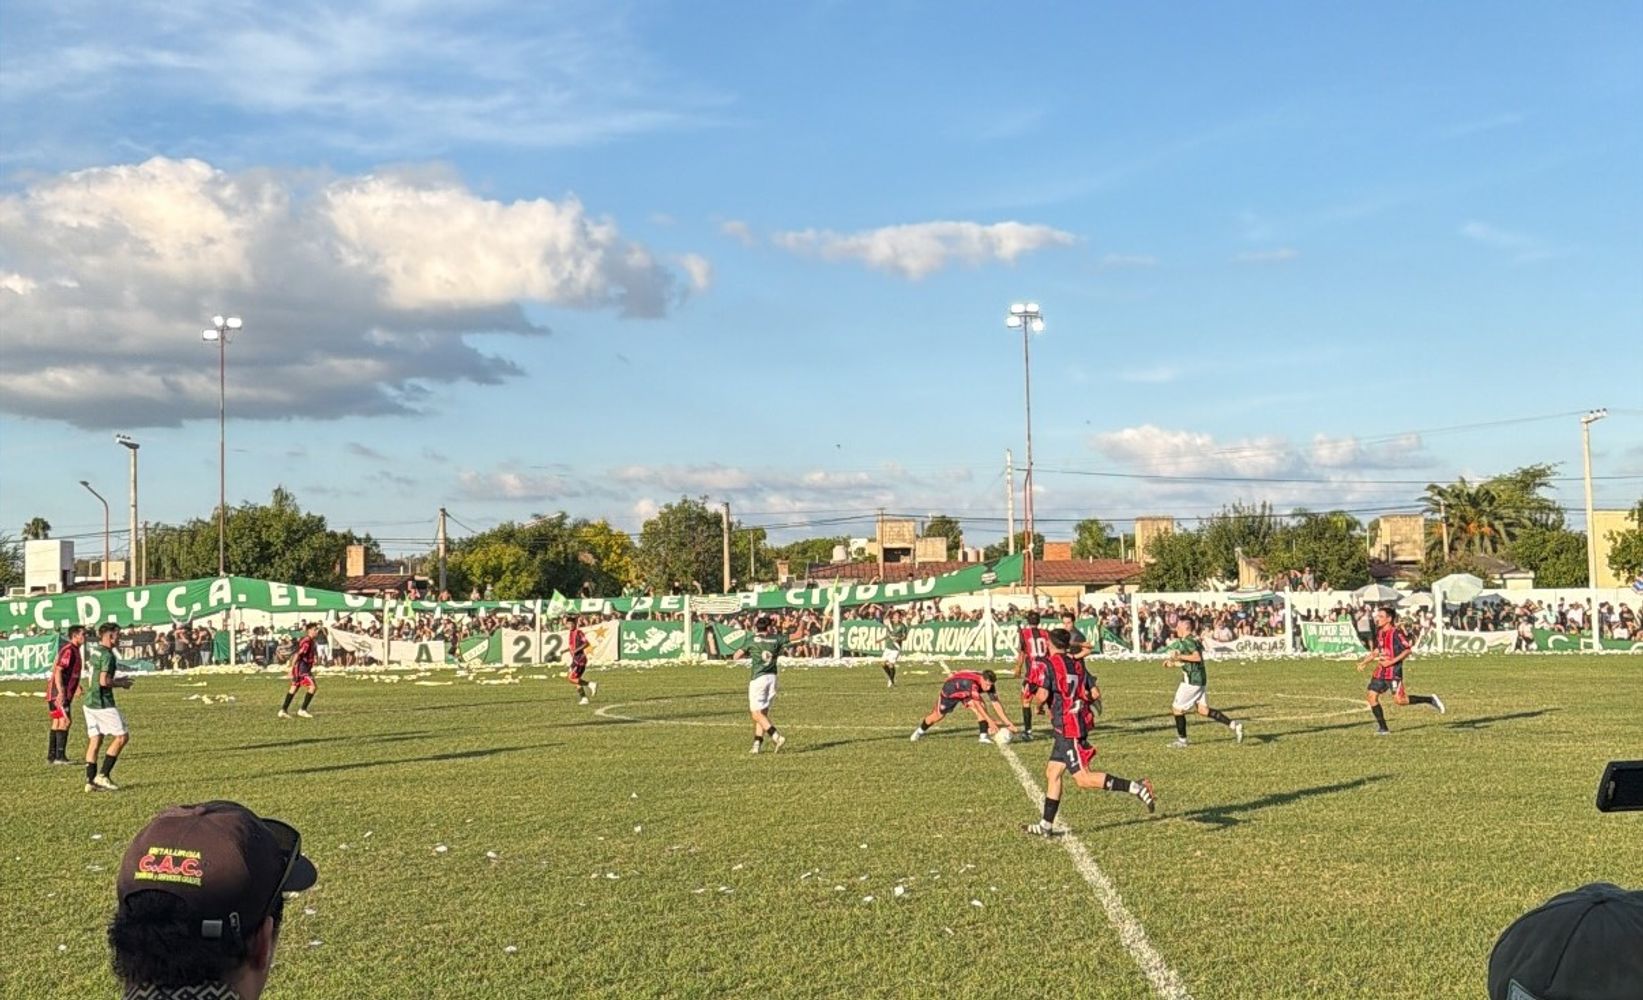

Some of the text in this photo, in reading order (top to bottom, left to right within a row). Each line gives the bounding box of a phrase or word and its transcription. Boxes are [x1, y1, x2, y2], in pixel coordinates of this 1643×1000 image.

[126, 590, 149, 620] Y
[166, 578, 247, 616] C.A.
[268, 582, 317, 606] EL
[631, 595, 681, 610] DE
[623, 631, 636, 640] LA
[901, 627, 935, 652] MOR
[1236, 638, 1286, 652] GRACIAS
[624, 642, 640, 654] 22
[1027, 637, 1047, 658] 10
[1066, 674, 1078, 699] 7
[139, 854, 203, 877] C.A.C.
